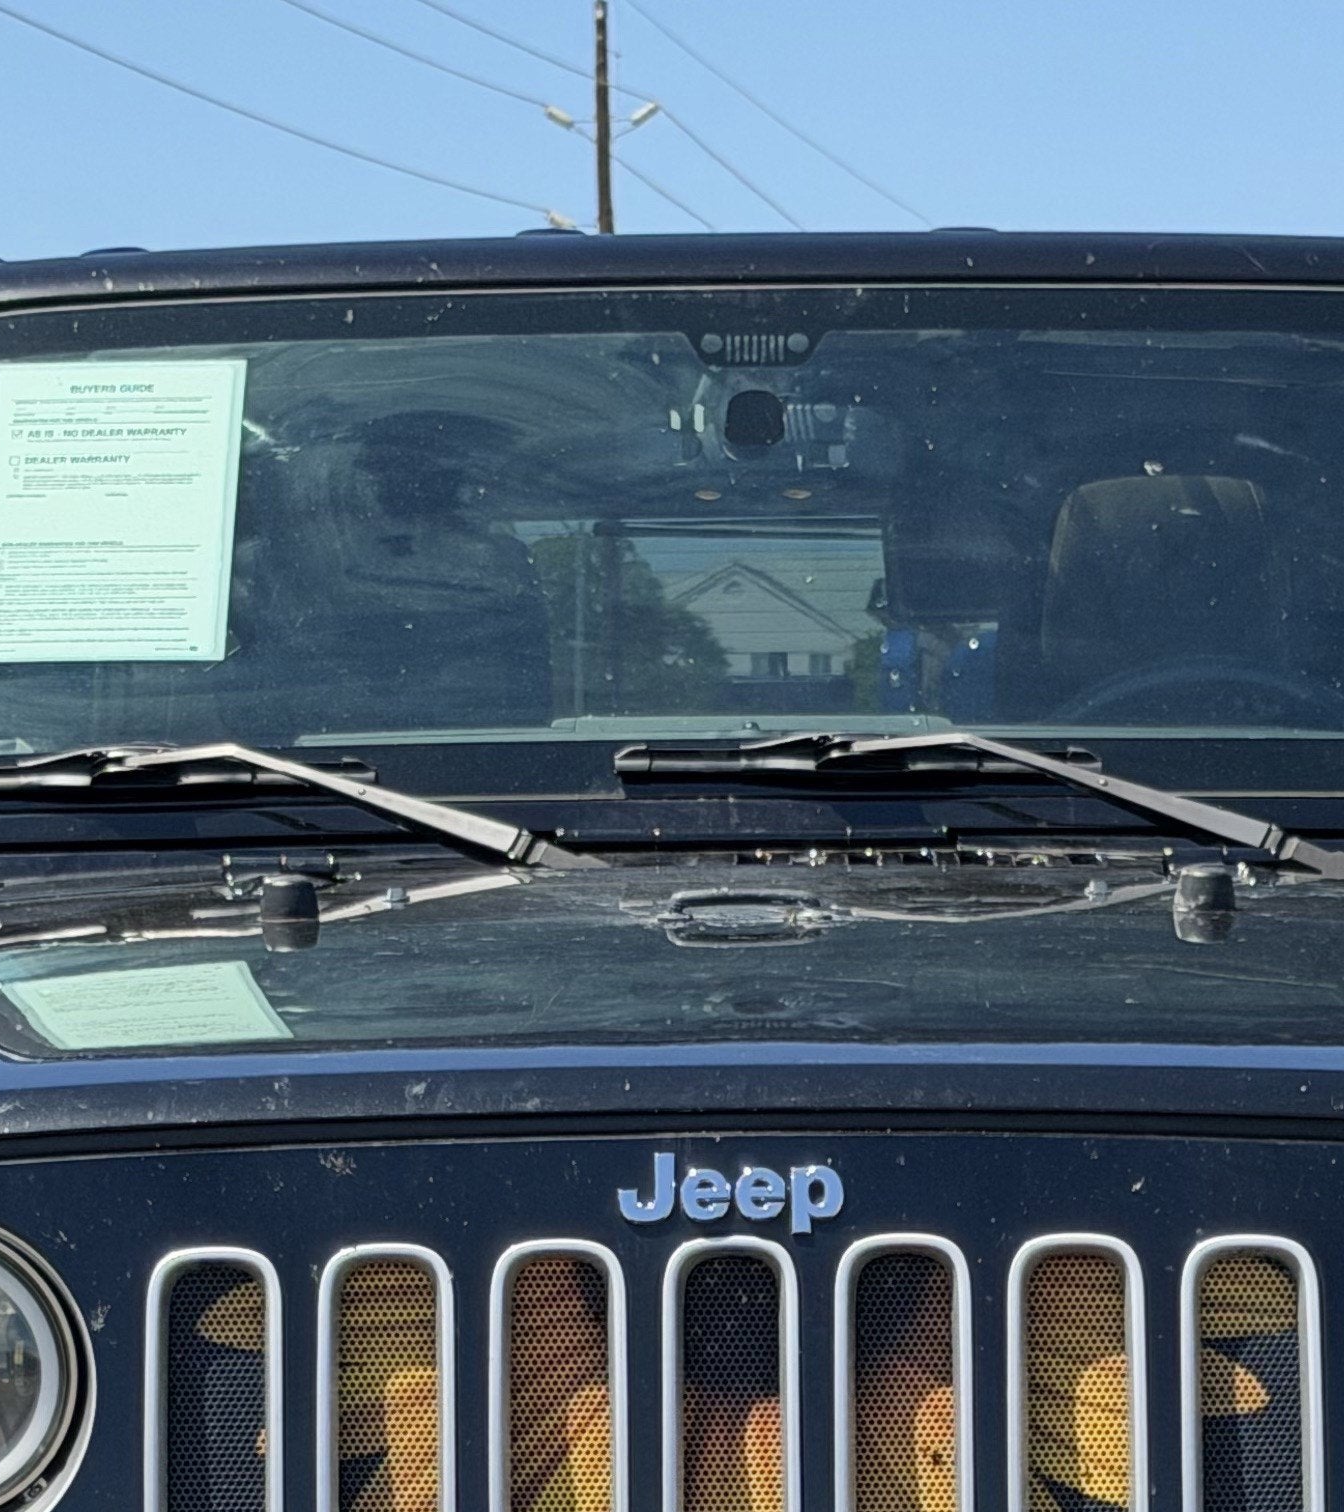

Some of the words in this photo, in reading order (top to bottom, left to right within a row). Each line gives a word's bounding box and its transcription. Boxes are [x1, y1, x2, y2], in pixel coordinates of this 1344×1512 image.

[70, 384, 116, 394] BUYERS
[119, 383, 155, 393] GUIDE
[27, 429, 41, 438] AS
[44, 429, 54, 438] IS
[63, 429, 79, 437] NO
[81, 428, 124, 437] DEALER
[126, 427, 187, 436] WARRANTY
[24, 456, 67, 464] DEALER
[69, 454, 131, 464] WARRANTY
[617, 1151, 845, 1234] Jeep
